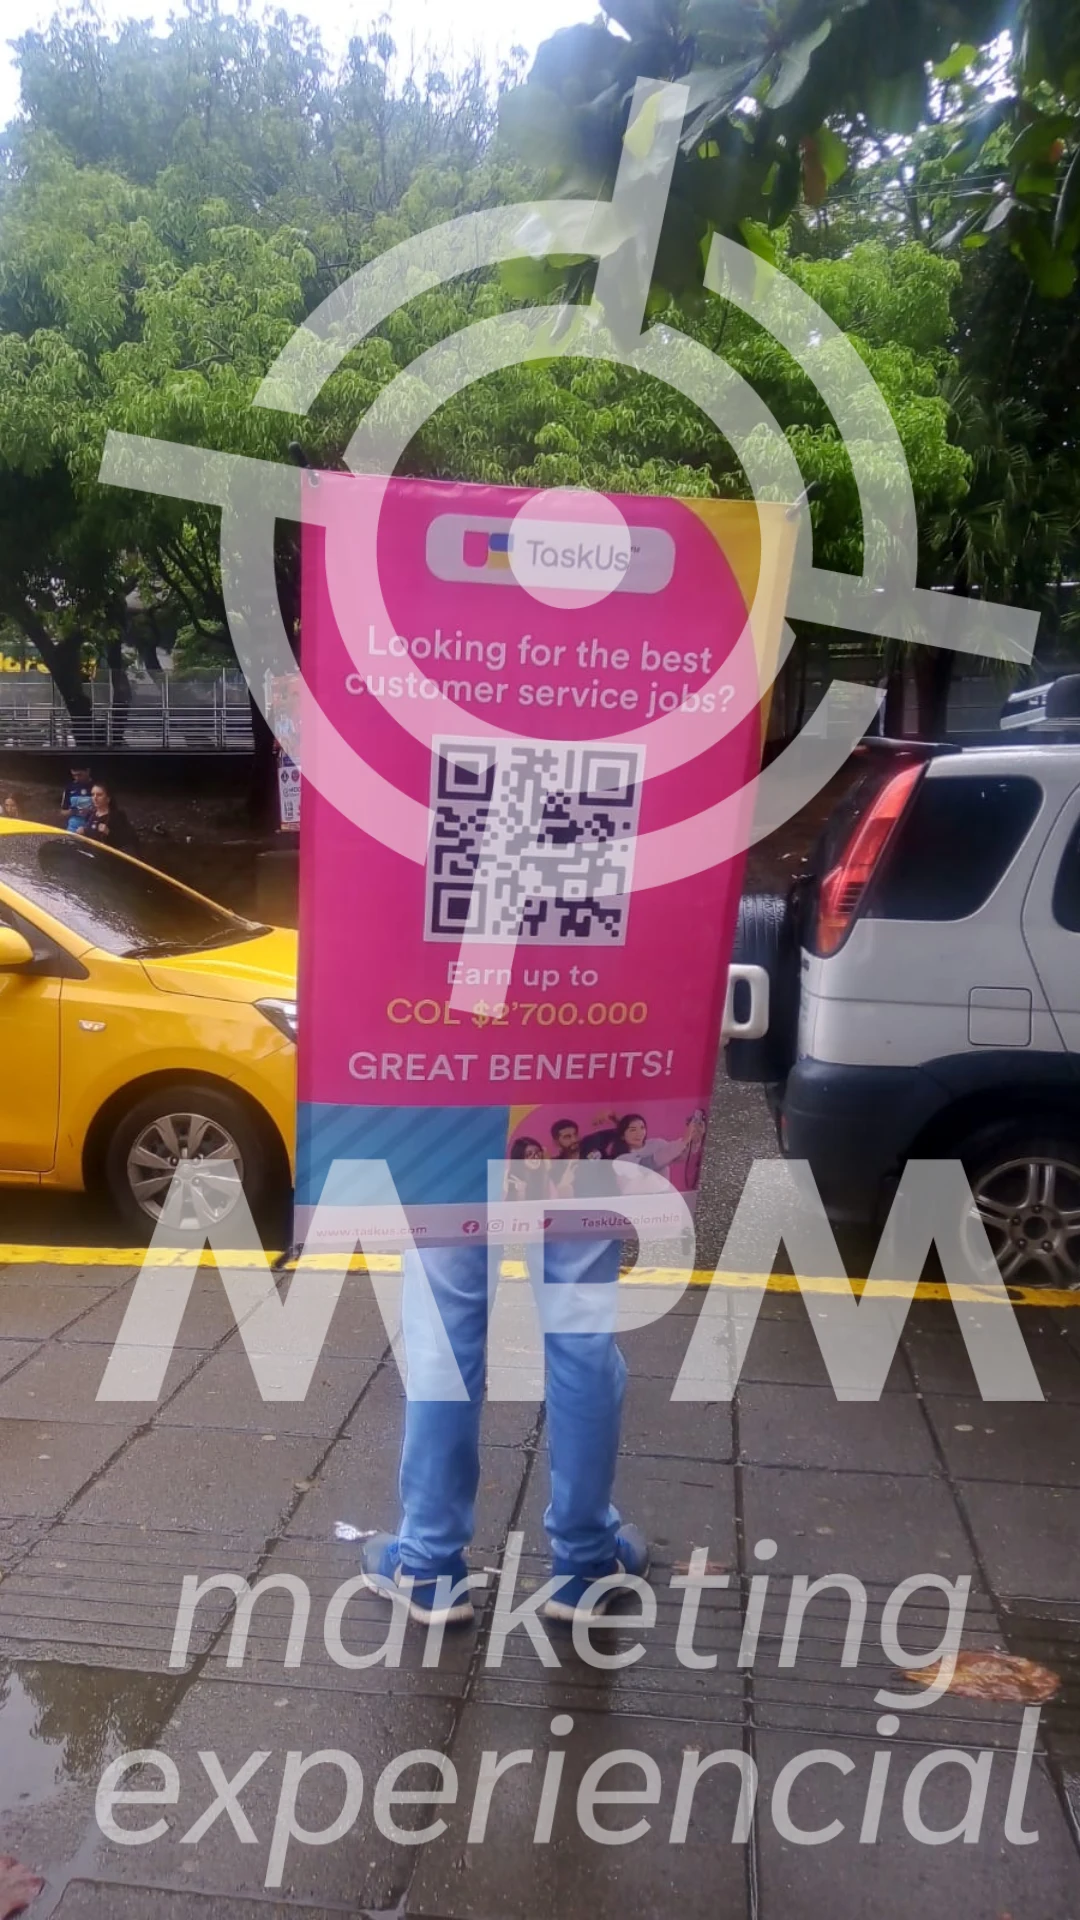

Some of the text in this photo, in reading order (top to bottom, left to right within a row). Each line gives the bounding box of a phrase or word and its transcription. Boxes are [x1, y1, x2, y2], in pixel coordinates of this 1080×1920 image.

[368, 625, 713, 674] Looking for the best
[345, 672, 735, 719] customer service jobs?
[446, 961, 600, 992] Earn up to
[386, 998, 461, 1025] COL
[347, 1050, 674, 1082] GREAT BENEFITS!
[316, 1224, 428, 1238] www.taskus.com
[581, 1213, 680, 1228] TaskUsColombia
